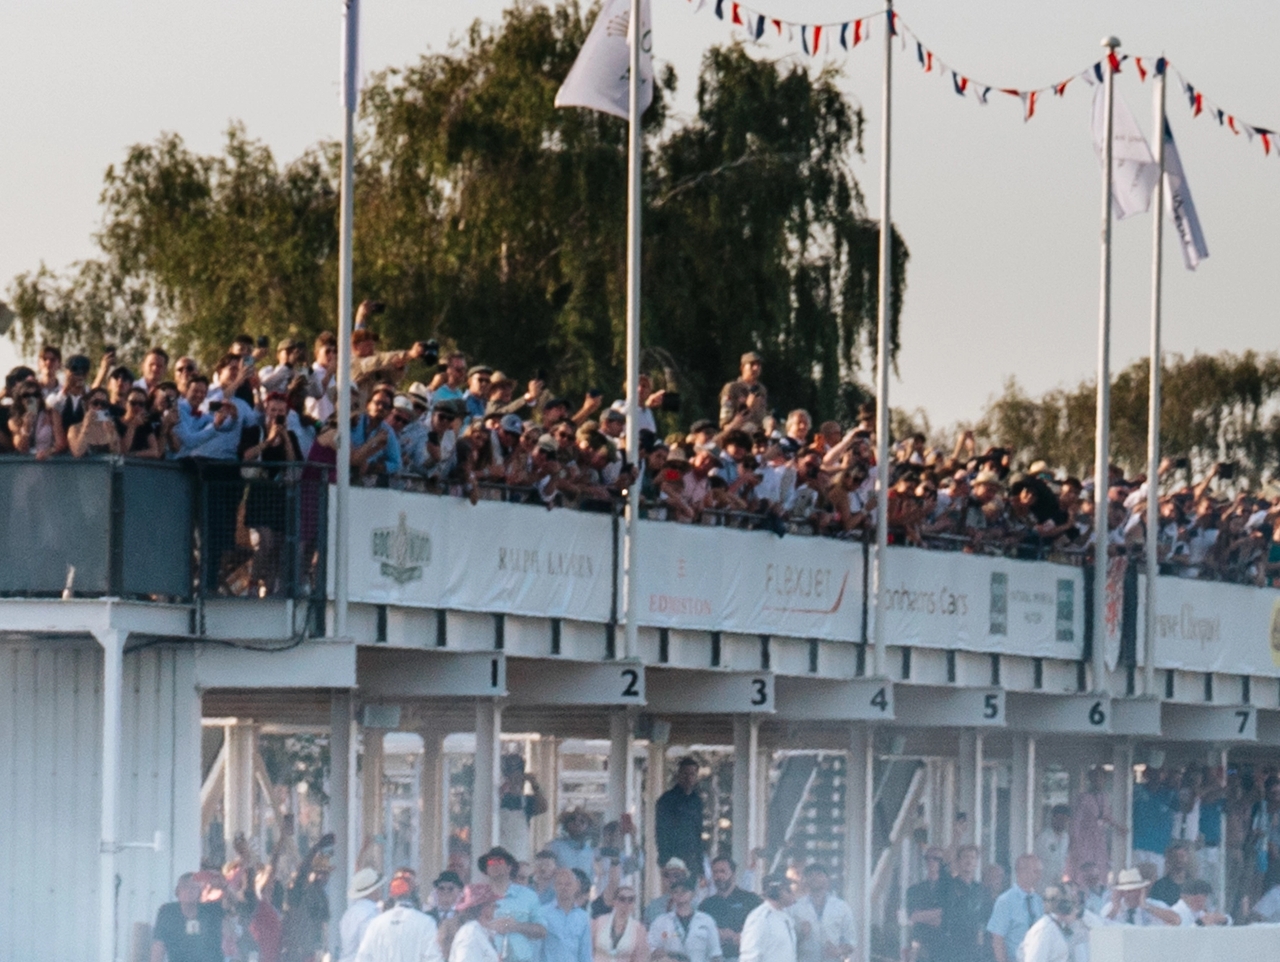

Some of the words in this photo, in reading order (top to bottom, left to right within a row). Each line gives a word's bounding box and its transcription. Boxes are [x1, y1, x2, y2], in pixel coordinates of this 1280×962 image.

[491, 658, 499, 688] 1
[620, 668, 640, 697] 2
[750, 678, 768, 706] 3
[869, 687, 888, 712] 4
[983, 694, 998, 719] 5
[1088, 701, 1105, 725] 6
[1234, 710, 1250, 734] 7
